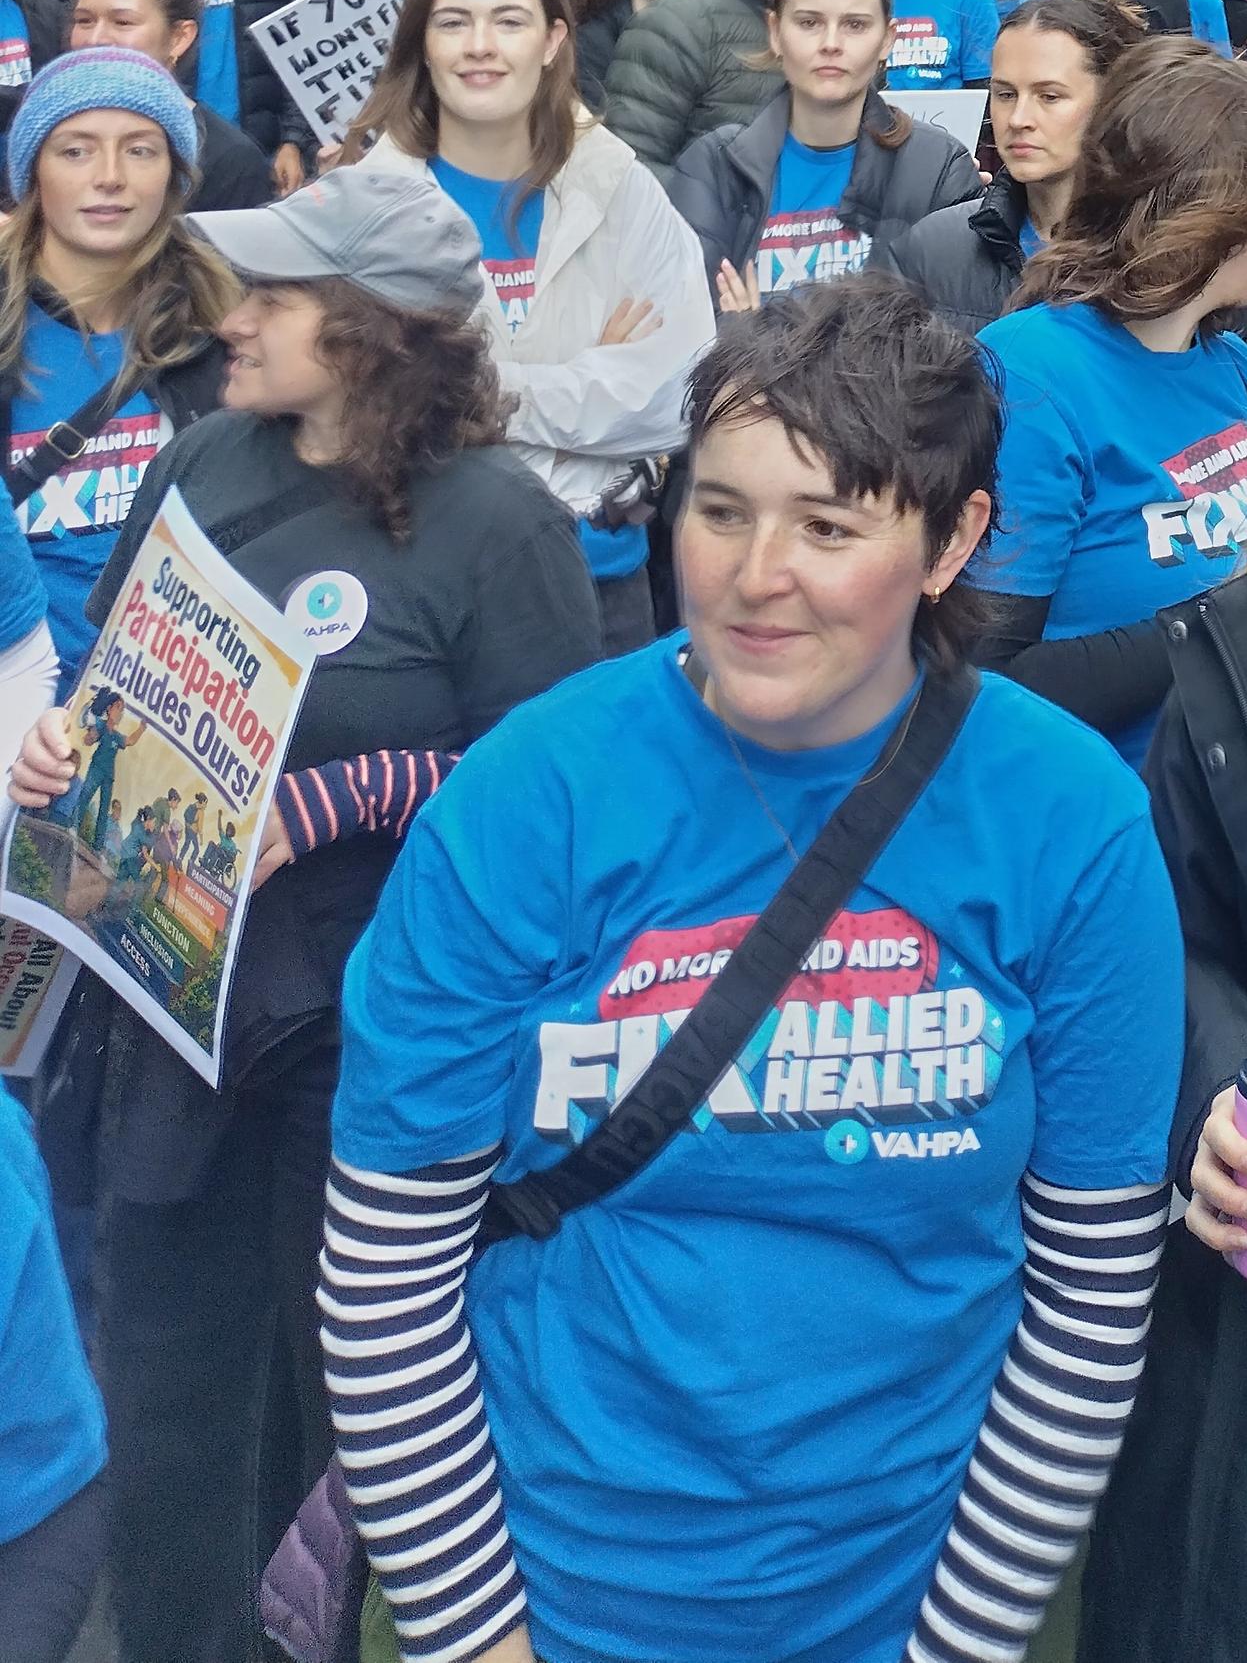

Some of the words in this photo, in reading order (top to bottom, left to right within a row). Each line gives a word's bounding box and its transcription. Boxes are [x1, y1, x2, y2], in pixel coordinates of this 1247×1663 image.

[267, 10, 300, 47] IF
[288, 16, 376, 75] WONT
[304, 52, 372, 94] THE
[770, 222, 811, 237] MORE
[494, 269, 536, 288] BAND
[755, 244, 819, 292] IX
[1204, 449, 1234, 478] BAND
[152, 556, 261, 688] Supporting
[120, 580, 276, 768] Participation
[101, 630, 188, 737] Includes
[194, 707, 262, 807] Ours!
[184, 884, 216, 917] MEANING
[191, 868, 234, 908] PARTICIPATION
[140, 924, 174, 970] INCLUSION
[152, 907, 192, 952] FUNCTION
[120, 934, 150, 978] ACCESS
[607, 961, 657, 996] NO
[660, 948, 736, 986] MOR
[800, 939, 844, 973] ND
[849, 936, 922, 971] AIDS
[766, 986, 987, 1059] ALLIED
[762, 1043, 987, 1114] HEALTH
[870, 1128, 982, 1160] VAHPA
